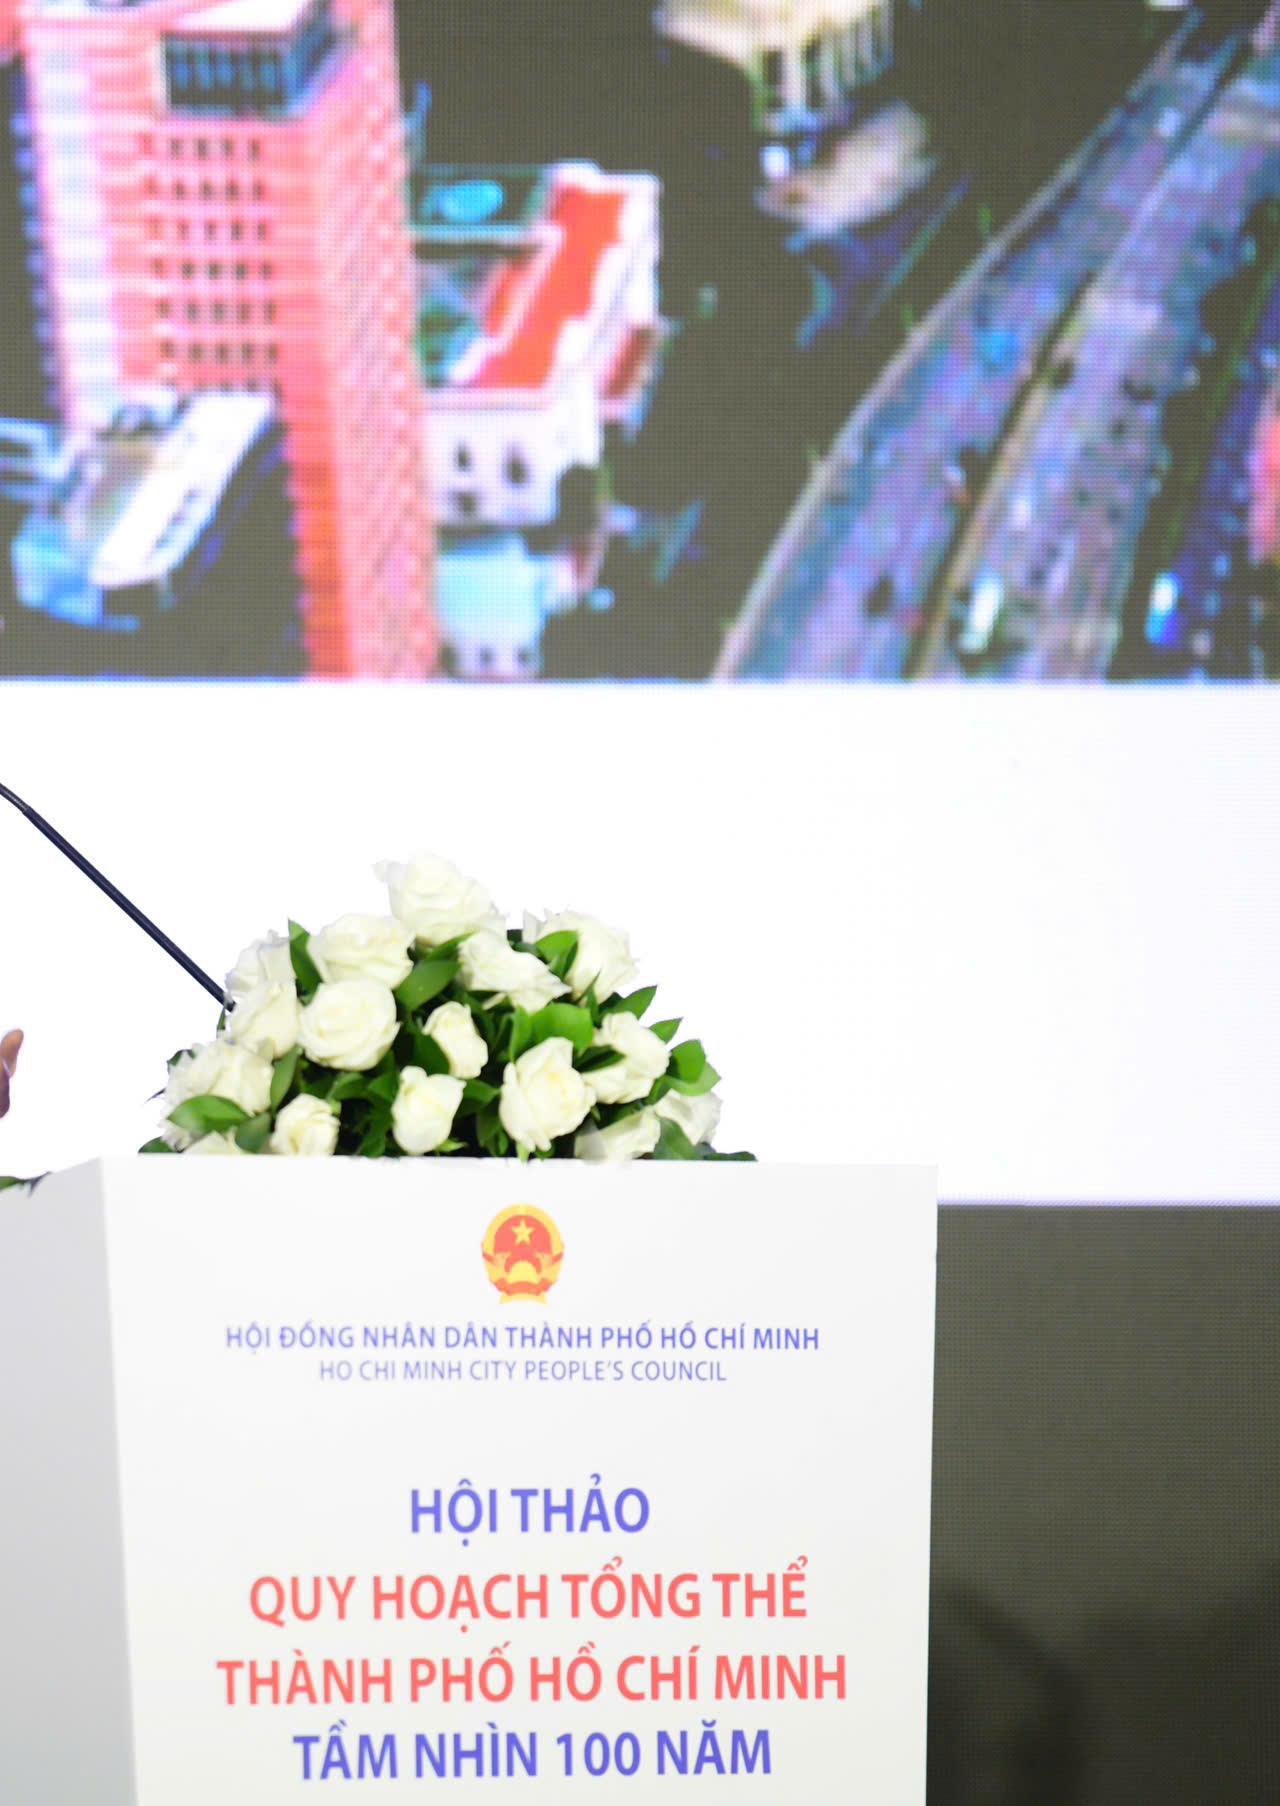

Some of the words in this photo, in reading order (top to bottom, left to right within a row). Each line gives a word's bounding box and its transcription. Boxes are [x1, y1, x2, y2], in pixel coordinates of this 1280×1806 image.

[226, 1322, 270, 1354] HỘI
[363, 1322, 436, 1349] NHÂN
[445, 1322, 498, 1349] DÂN
[505, 1322, 593, 1349] THÀNH
[601, 1320, 654, 1350] PHỐ
[704, 1323, 746, 1350] CHÍ
[753, 1327, 820, 1351] MINH
[319, 1361, 352, 1380] HO
[359, 1361, 396, 1380] CHI
[403, 1361, 462, 1380] MINH
[469, 1361, 517, 1380] CITY
[524, 1360, 624, 1381] PEOPLE'S
[631, 1360, 727, 1382] COUNCIL
[411, 1478, 498, 1547] HỘI
[511, 1474, 650, 1534] THẢO
[250, 1575, 356, 1628] QUY
[373, 1573, 549, 1633] HOẠCH
[561, 1556, 701, 1620] TỔNG
[712, 1555, 808, 1618] THỂ
[216, 1648, 393, 1706] THÀNH
[410, 1642, 514, 1703] PHỐ
[530, 1642, 603, 1703] HỒ
[616, 1646, 700, 1702] CHÍ
[714, 1654, 847, 1701] MINH
[293, 1720, 398, 1780] TẦM
[415, 1722, 538, 1778] NHÌN
[556, 1731, 642, 1777] 100
[657, 1719, 772, 1776] NĂM
